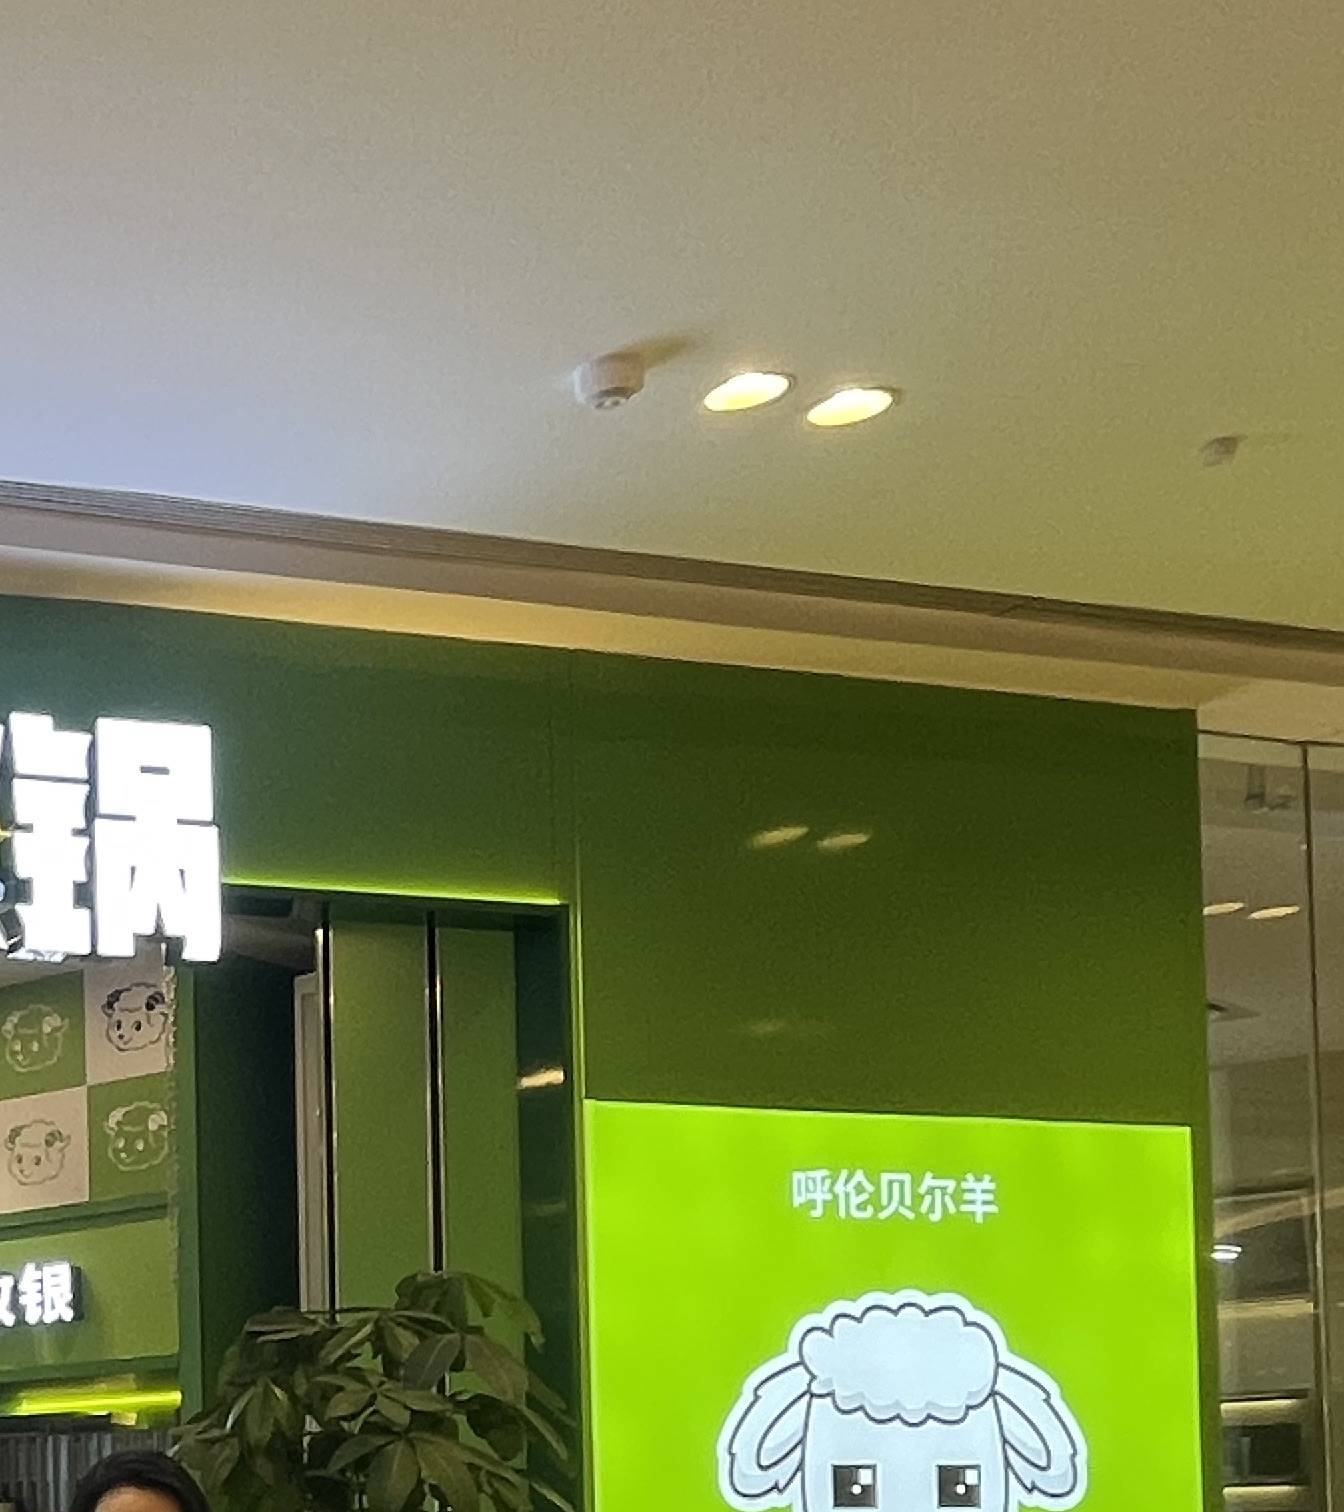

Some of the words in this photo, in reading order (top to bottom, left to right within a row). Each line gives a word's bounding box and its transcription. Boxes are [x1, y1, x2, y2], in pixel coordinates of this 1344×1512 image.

[791, 1169, 1000, 1224] 呼伦贝尔羊
